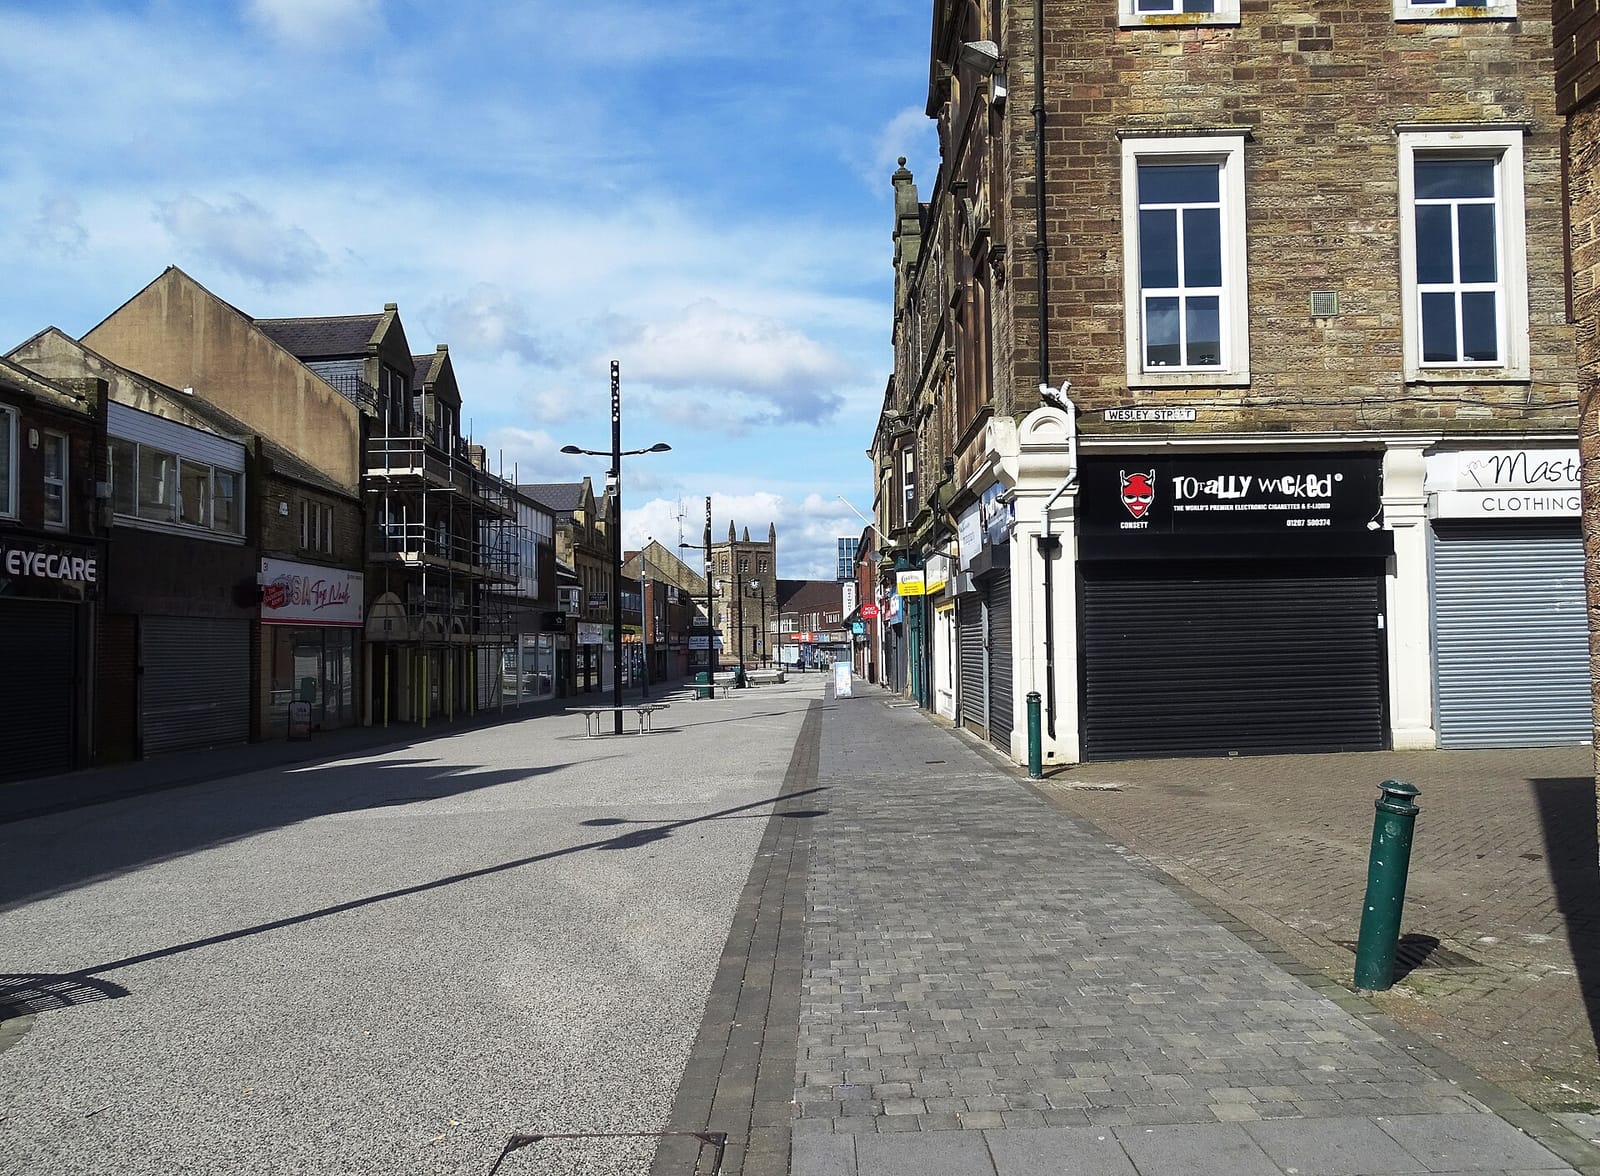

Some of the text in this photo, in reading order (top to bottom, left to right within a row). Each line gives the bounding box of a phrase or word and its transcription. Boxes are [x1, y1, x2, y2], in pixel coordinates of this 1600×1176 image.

[1109, 410, 1148, 420] WESLEY
[1173, 504, 1184, 512] THE
[1235, 503, 1267, 511] ELECTRONIC
[1482, 496, 1581, 511] CLOTHING
[1120, 521, 1149, 529] CONSETT
[1286, 519, 1306, 527] 01207
[5, 549, 96, 583] EYECARE
